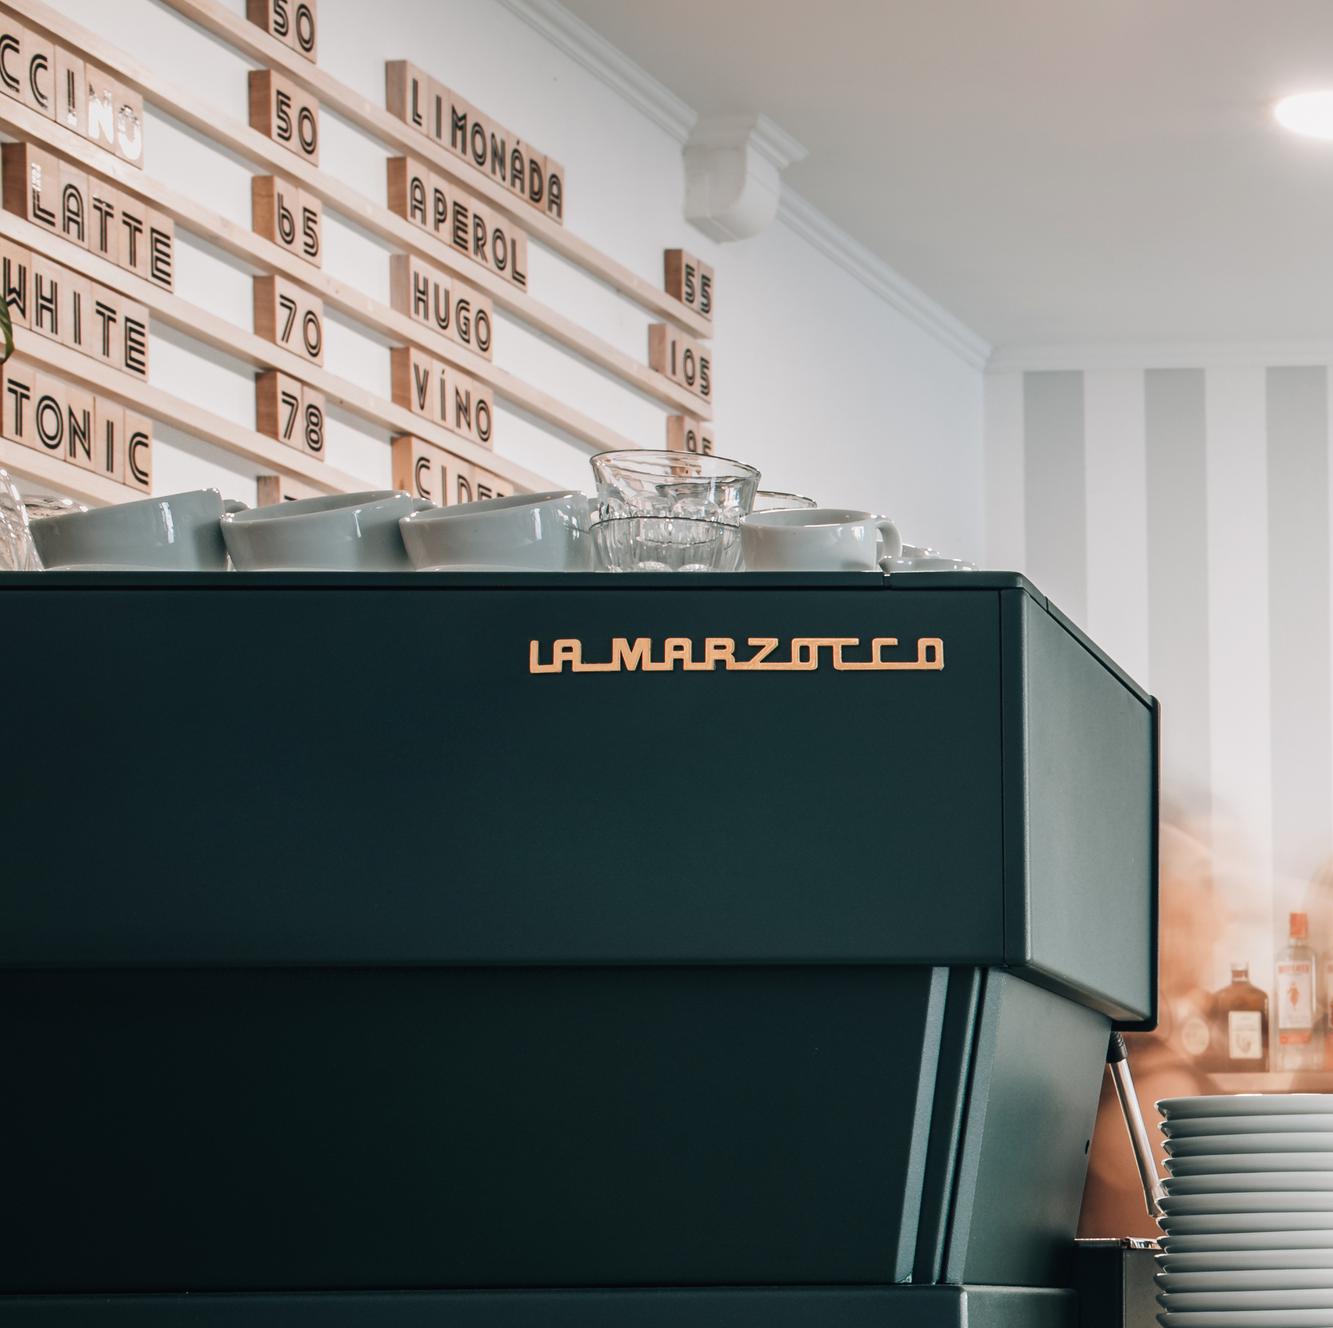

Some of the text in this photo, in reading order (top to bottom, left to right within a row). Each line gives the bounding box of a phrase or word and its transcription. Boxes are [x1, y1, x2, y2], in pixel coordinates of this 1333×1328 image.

[273, 0, 316, 53] 50
[276, 89, 318, 156] 50
[411, 77, 563, 220] LIMONÁDA
[31, 162, 172, 287] LATTE
[277, 192, 320, 258] 65
[410, 176, 527, 287] APEROL
[2, 256, 147, 376] WHITE
[413, 270, 492, 353] HUGO
[684, 263, 712, 315] 55
[279, 294, 323, 358] 70
[671, 340, 711, 397] 105
[7, 378, 150, 487] TONIC
[281, 391, 324, 452] 78
[413, 363, 492, 443] VÍNO
[414, 456, 507, 506] CID
[529, 636, 945, 674] LA MARZOCCO
